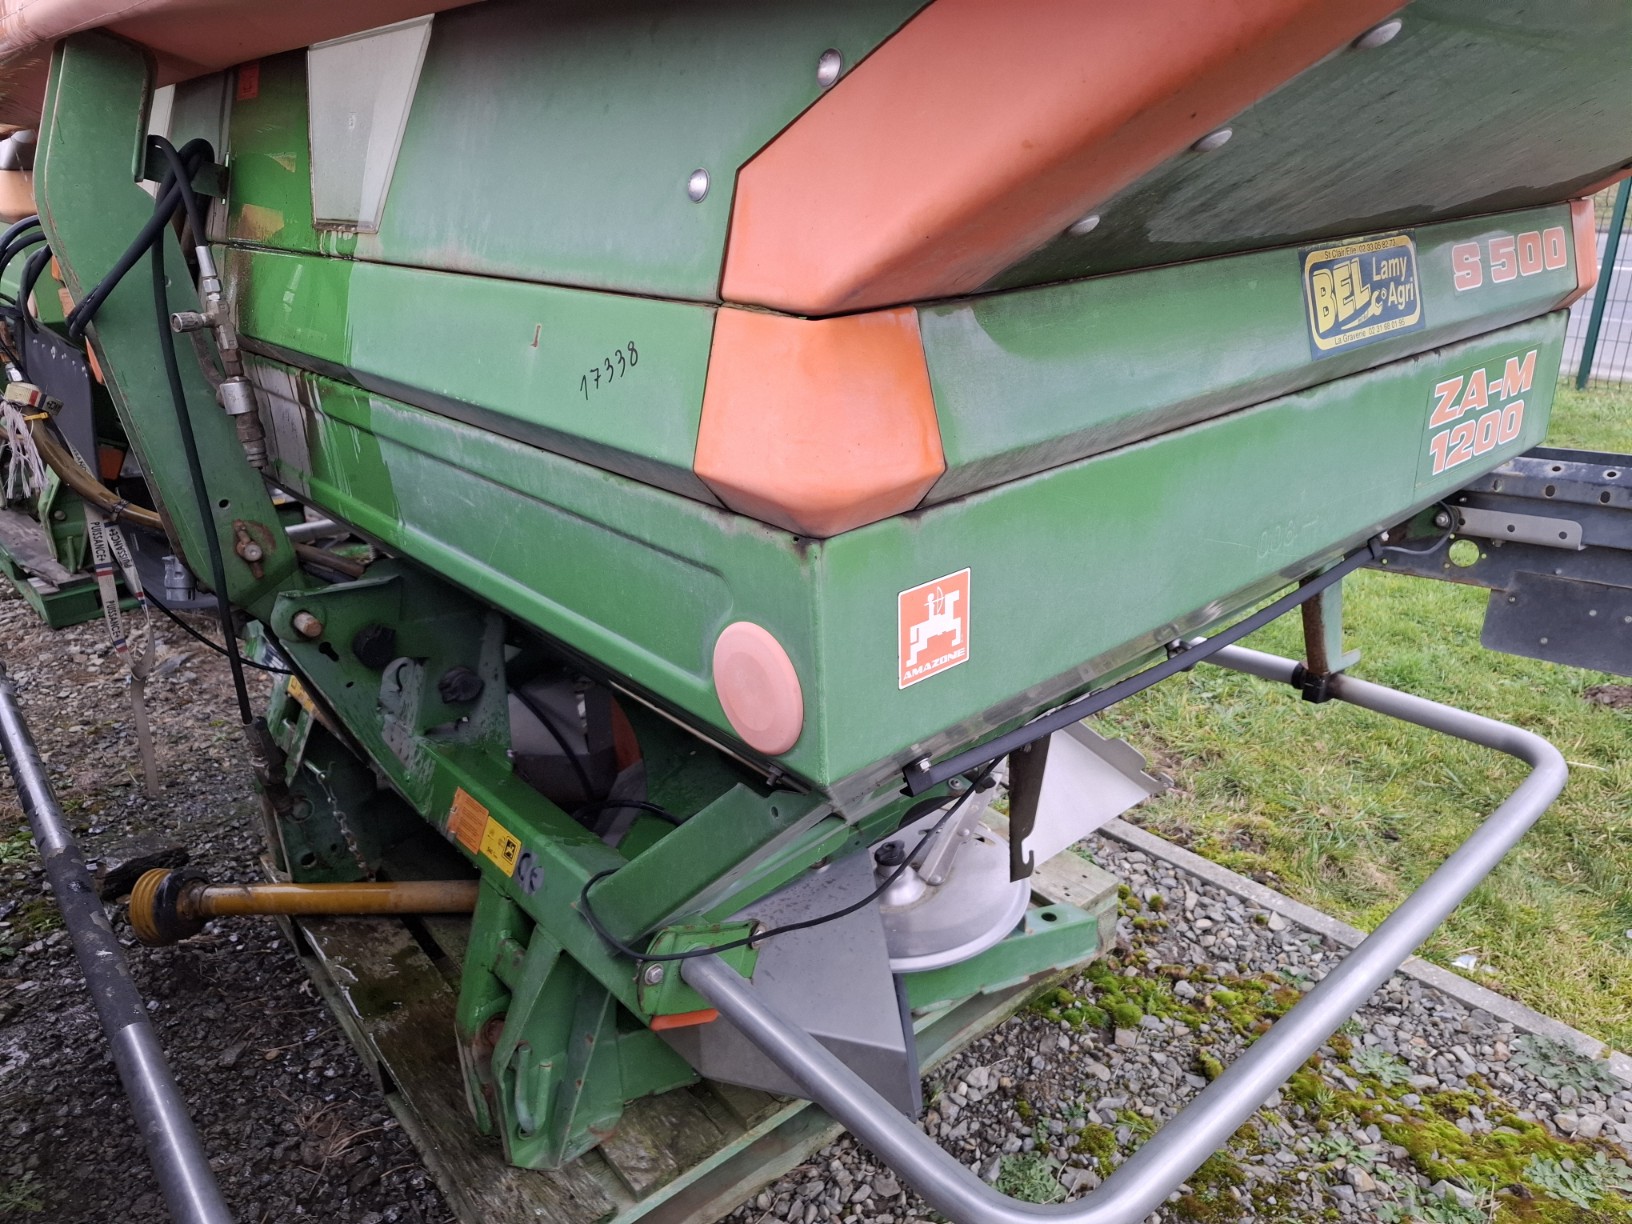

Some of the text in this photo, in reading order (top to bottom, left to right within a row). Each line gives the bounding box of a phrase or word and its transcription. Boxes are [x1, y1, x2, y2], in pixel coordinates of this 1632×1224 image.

[1372, 256, 1407, 282] Lamy
[1451, 226, 1567, 292] S 500
[1312, 256, 1371, 334] BEL
[1388, 277, 1414, 310] Agri
[579, 340, 639, 401] 17338
[1428, 349, 1538, 429] ZA-M
[1429, 399, 1525, 476] 1200
[903, 647, 966, 681] AMAZONE
